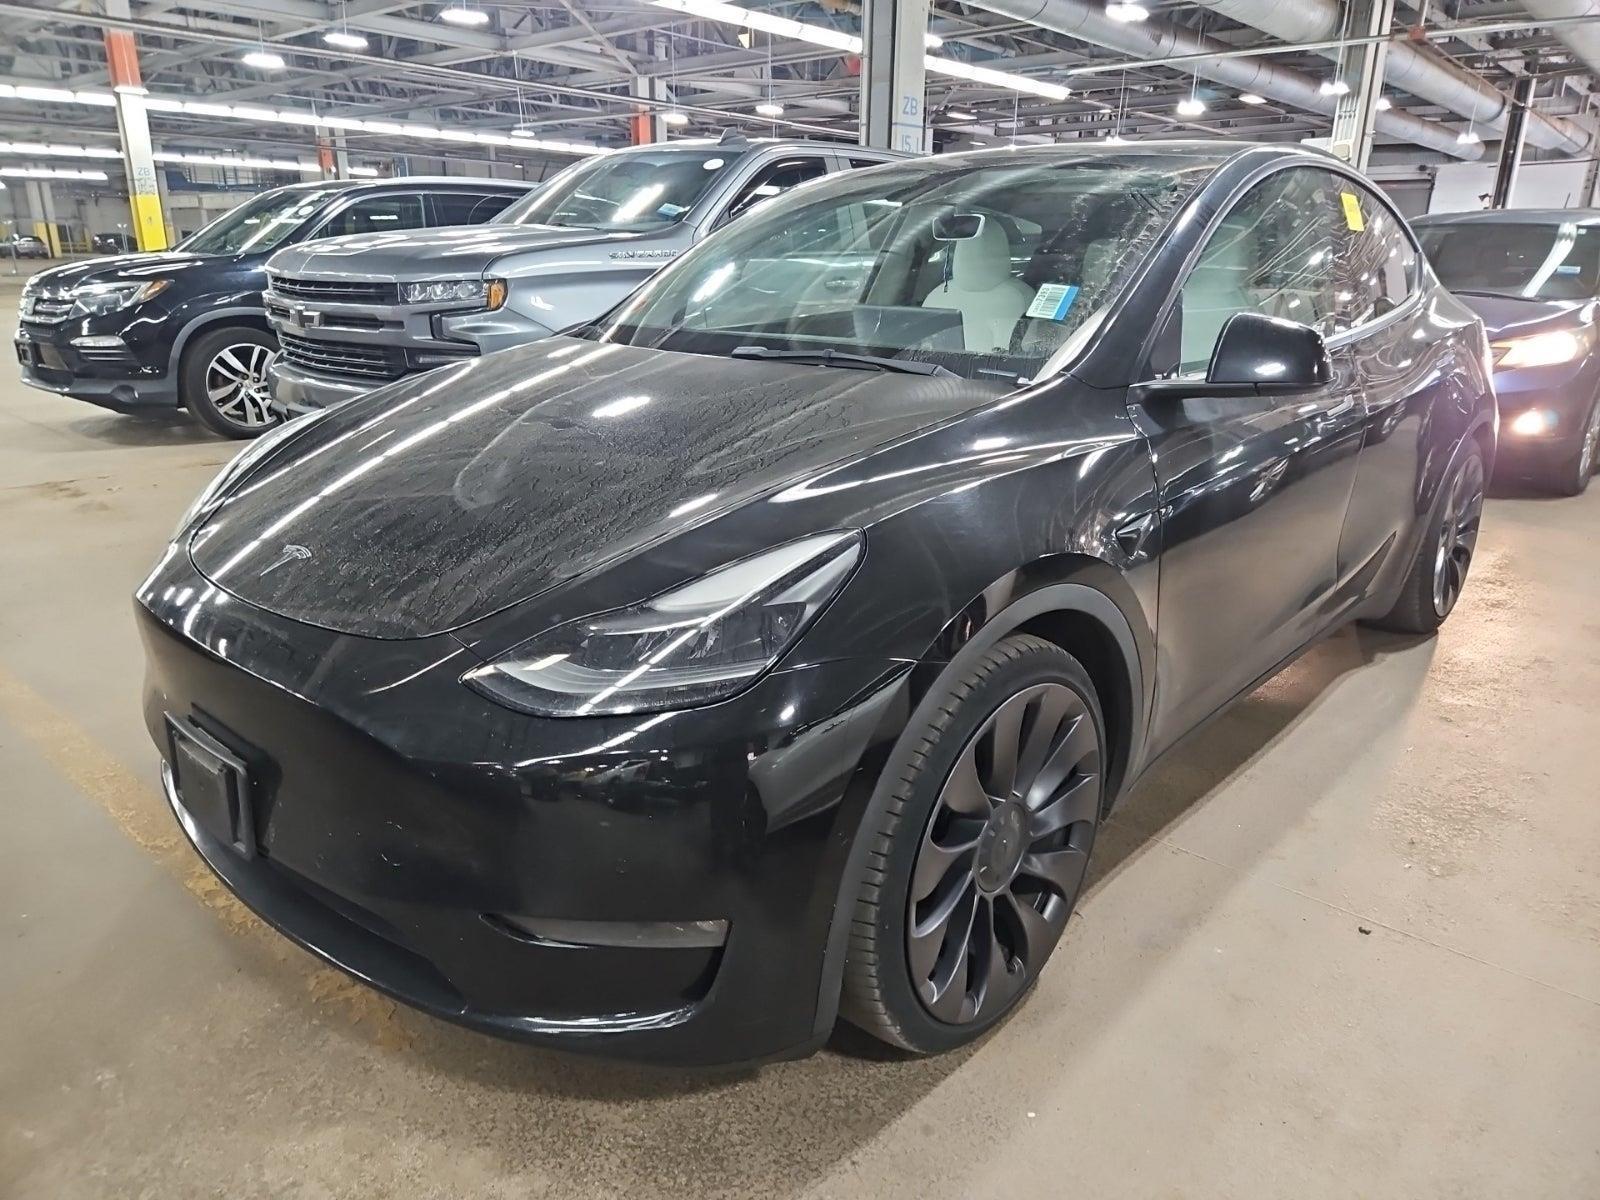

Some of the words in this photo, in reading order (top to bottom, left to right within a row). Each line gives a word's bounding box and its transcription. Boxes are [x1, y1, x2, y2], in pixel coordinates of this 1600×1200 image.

[902, 96, 918, 116] ZB
[137, 167, 151, 176] ZB
[607, 249, 679, 260] SILVERADO
